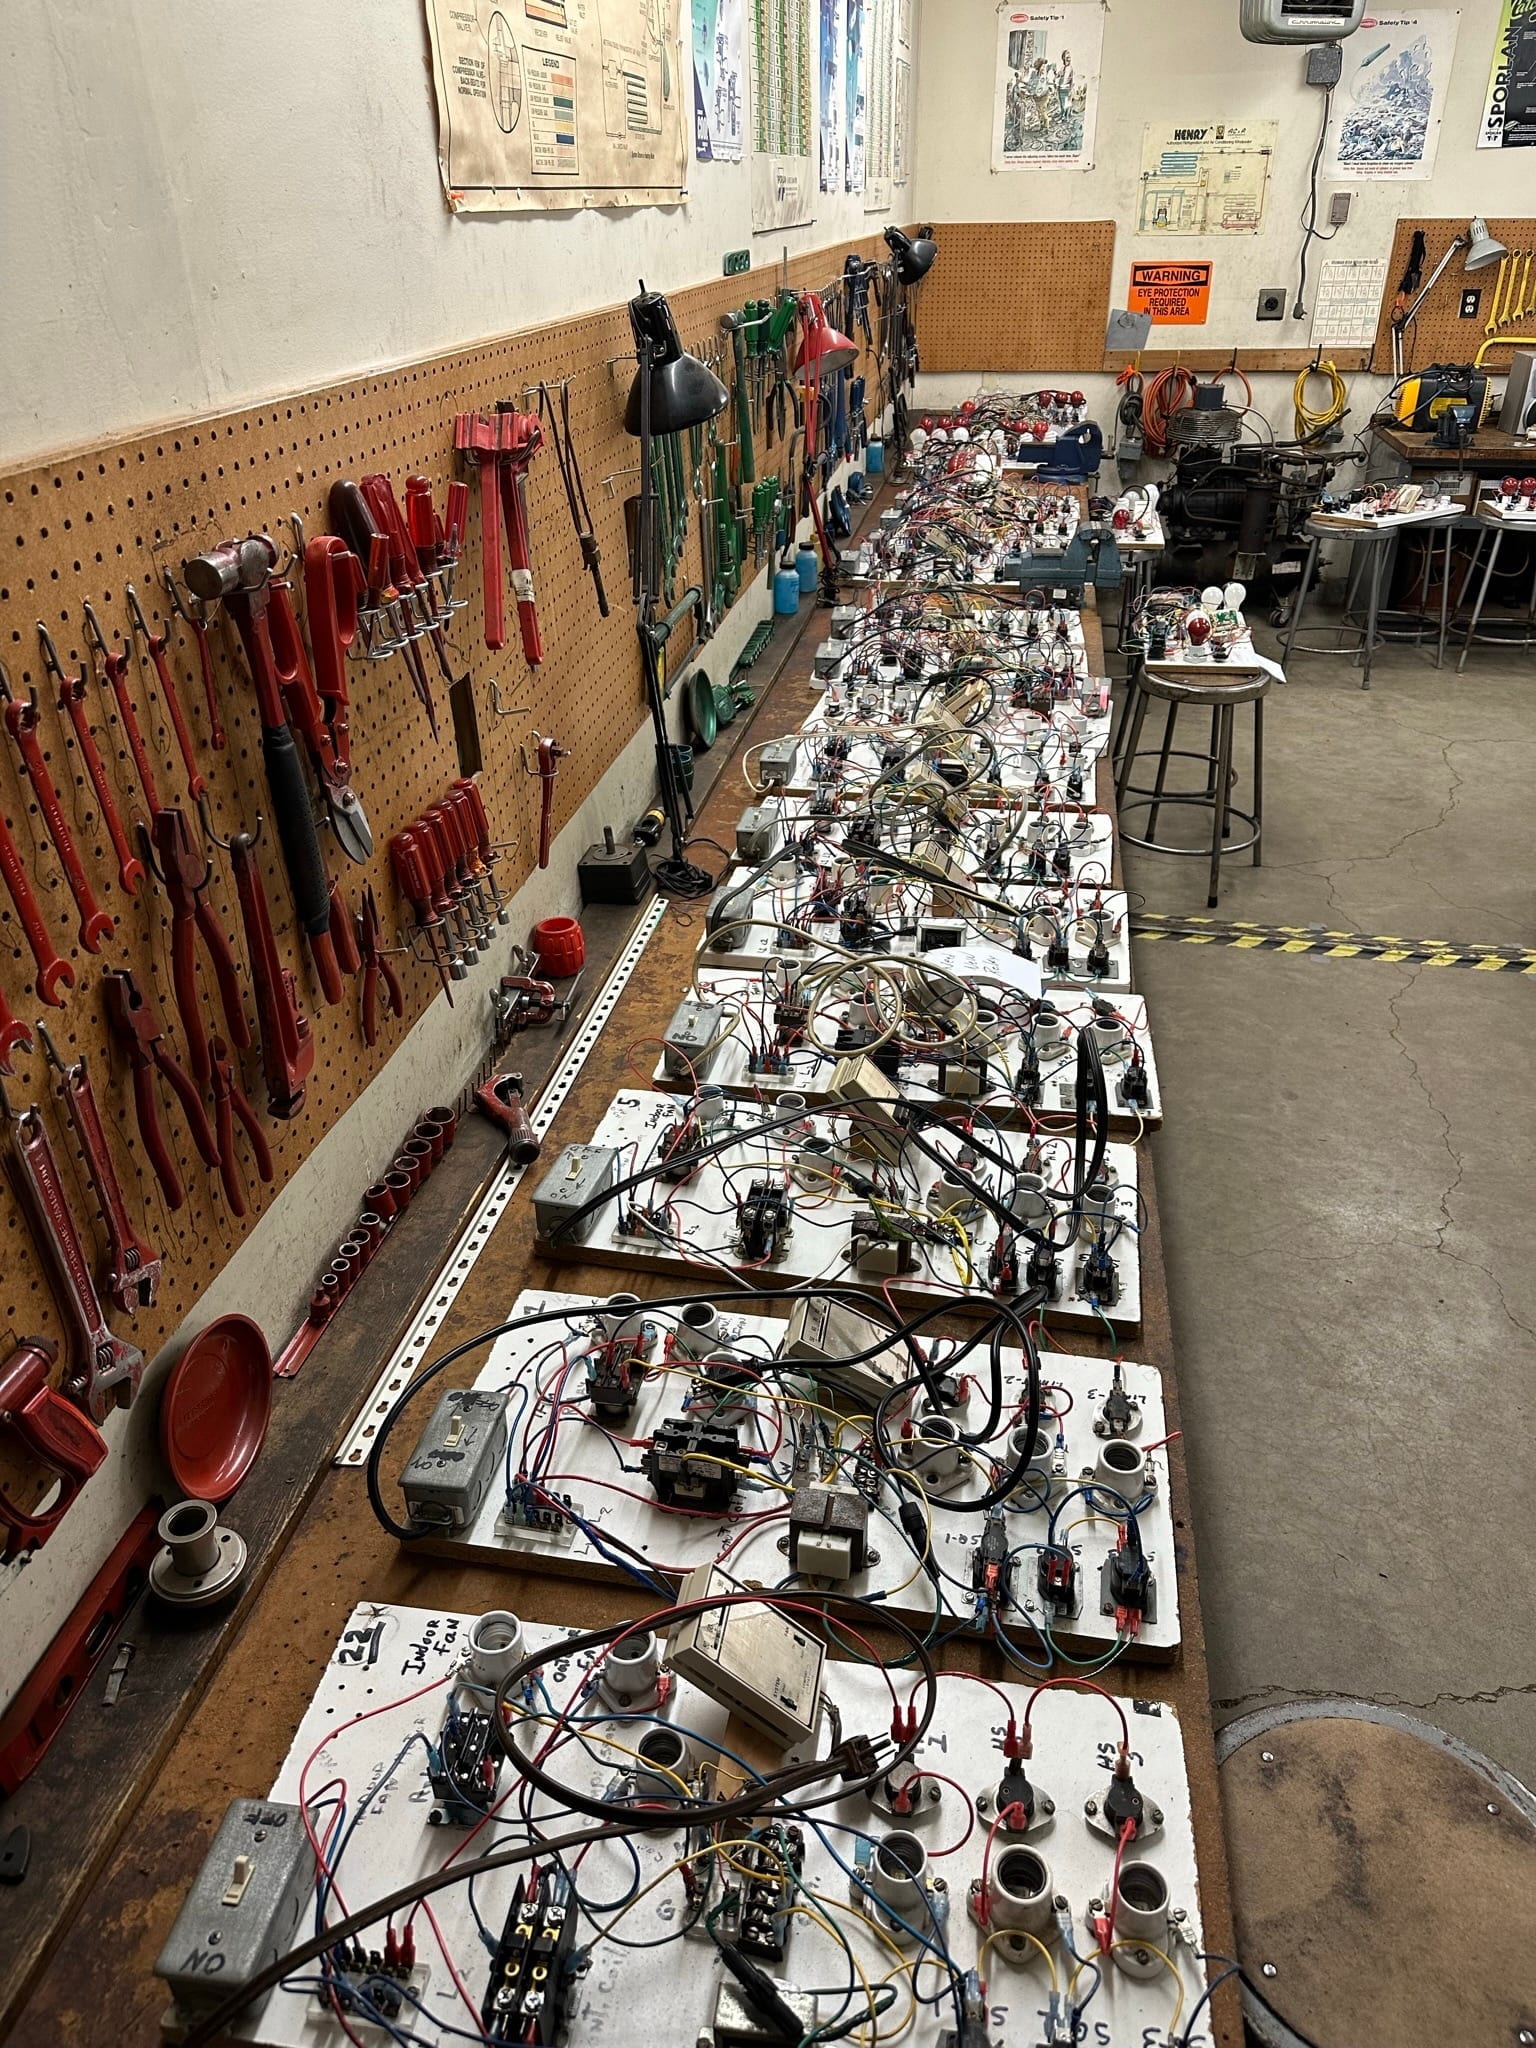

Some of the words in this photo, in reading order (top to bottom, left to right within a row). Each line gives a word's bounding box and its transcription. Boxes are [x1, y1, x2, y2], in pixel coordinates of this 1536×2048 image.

[1488, 26, 1522, 128] SPORLAN
[1174, 128, 1208, 140] HENRY
[1142, 270, 1200, 281] WARNING
[1138, 288, 1152, 297] EYE
[1154, 288, 1200, 297] PROTECTION
[1149, 298, 1186, 306] REQUIRED
[1153, 306, 1168, 316] THIS
[1170, 307, 1190, 316] AREA
[617, 1097, 641, 1108] 5
[339, 1628, 376, 1664] 22
[656, 1898, 676, 1921] G
[179, 1948, 226, 1975] ON
